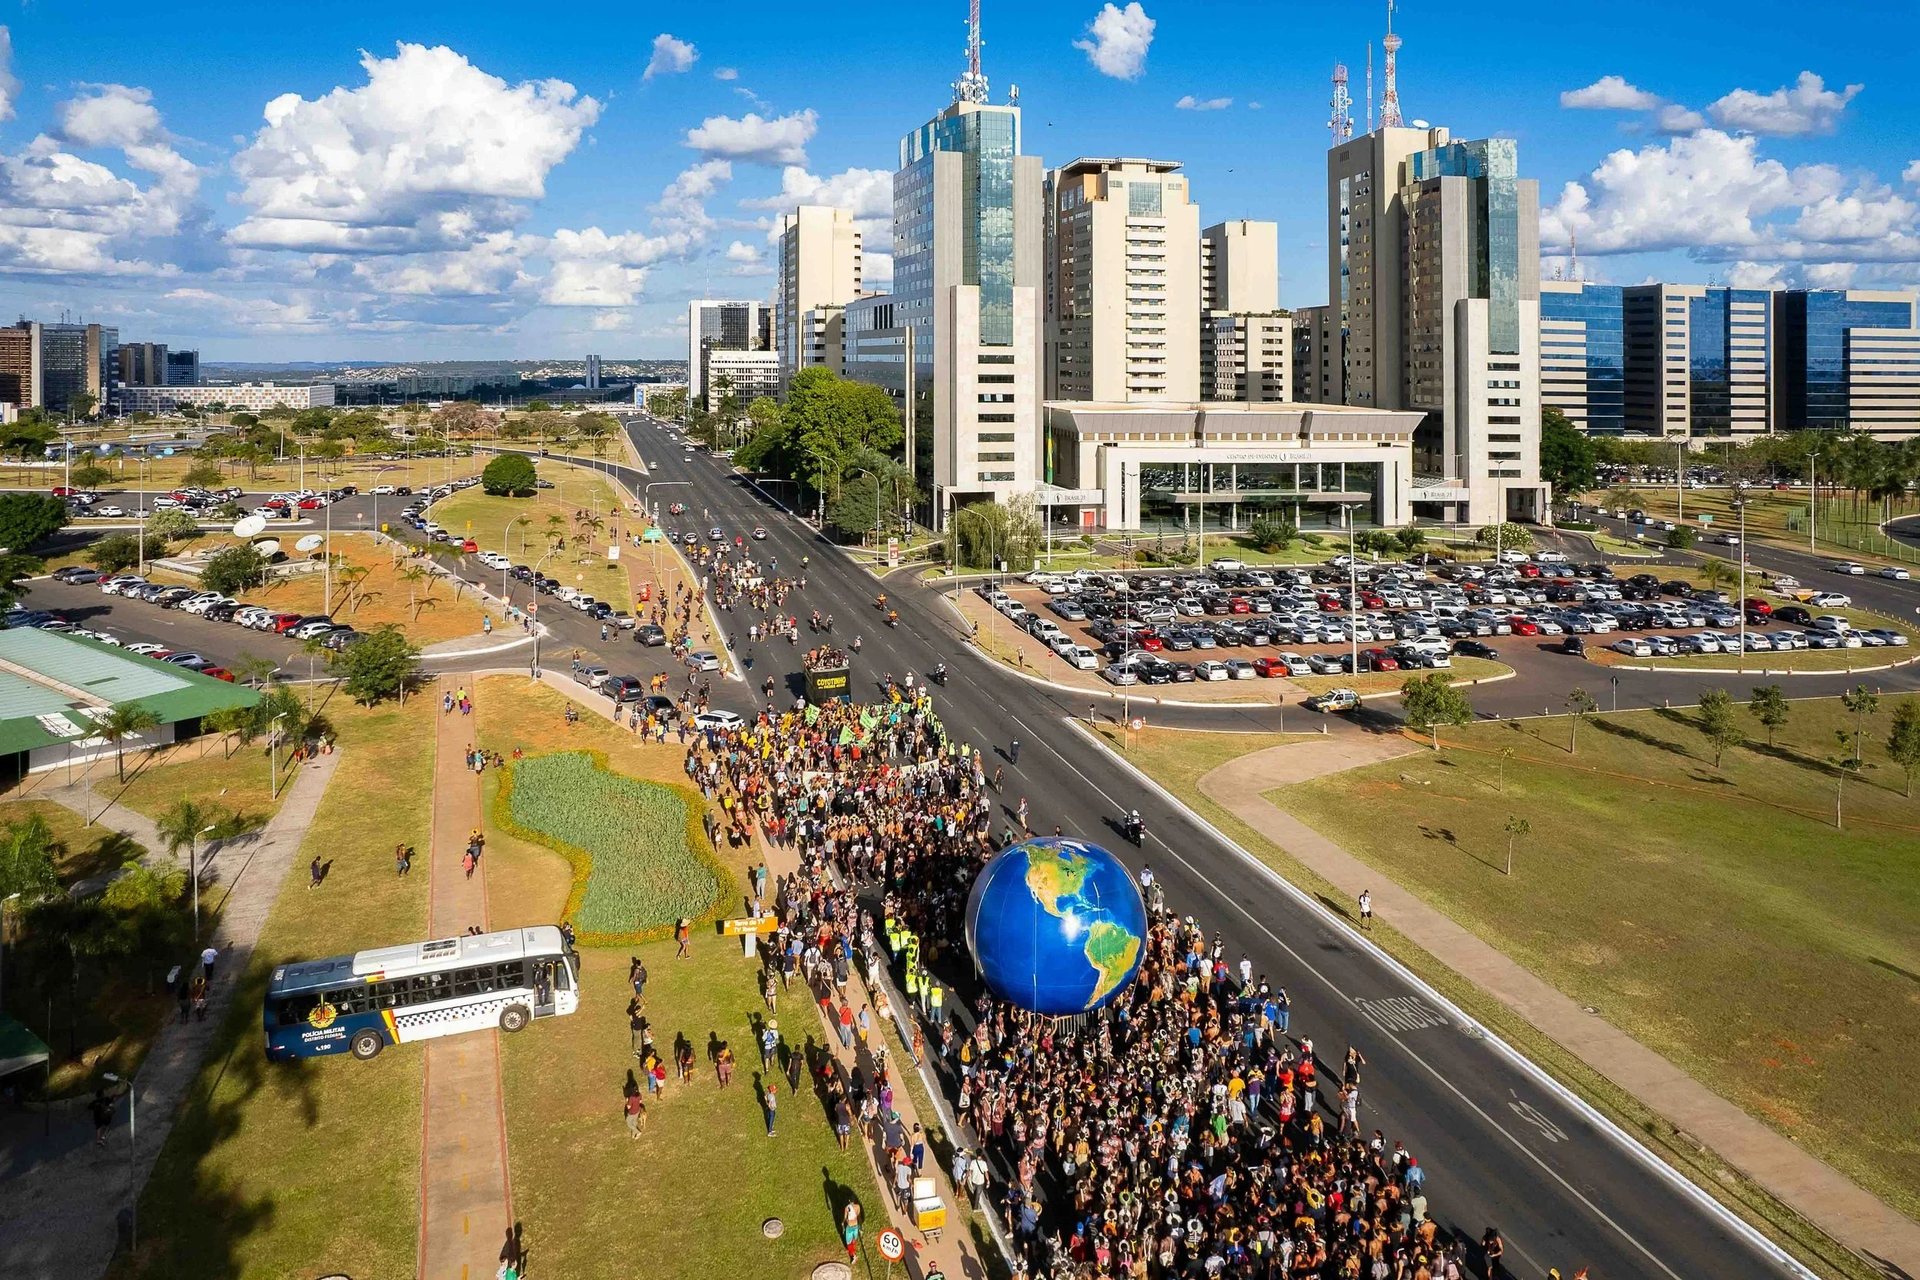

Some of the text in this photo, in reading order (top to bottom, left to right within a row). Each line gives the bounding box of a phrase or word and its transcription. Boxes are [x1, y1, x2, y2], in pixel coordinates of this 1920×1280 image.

[735, 917, 766, 927] Torre de TV
[1354, 995, 1449, 1032] ÔNIBUS
[302, 1027, 346, 1039] POLÍCIA MILITAR
[884, 1234, 899, 1248] 60
[883, 1244, 899, 1254] km/h
